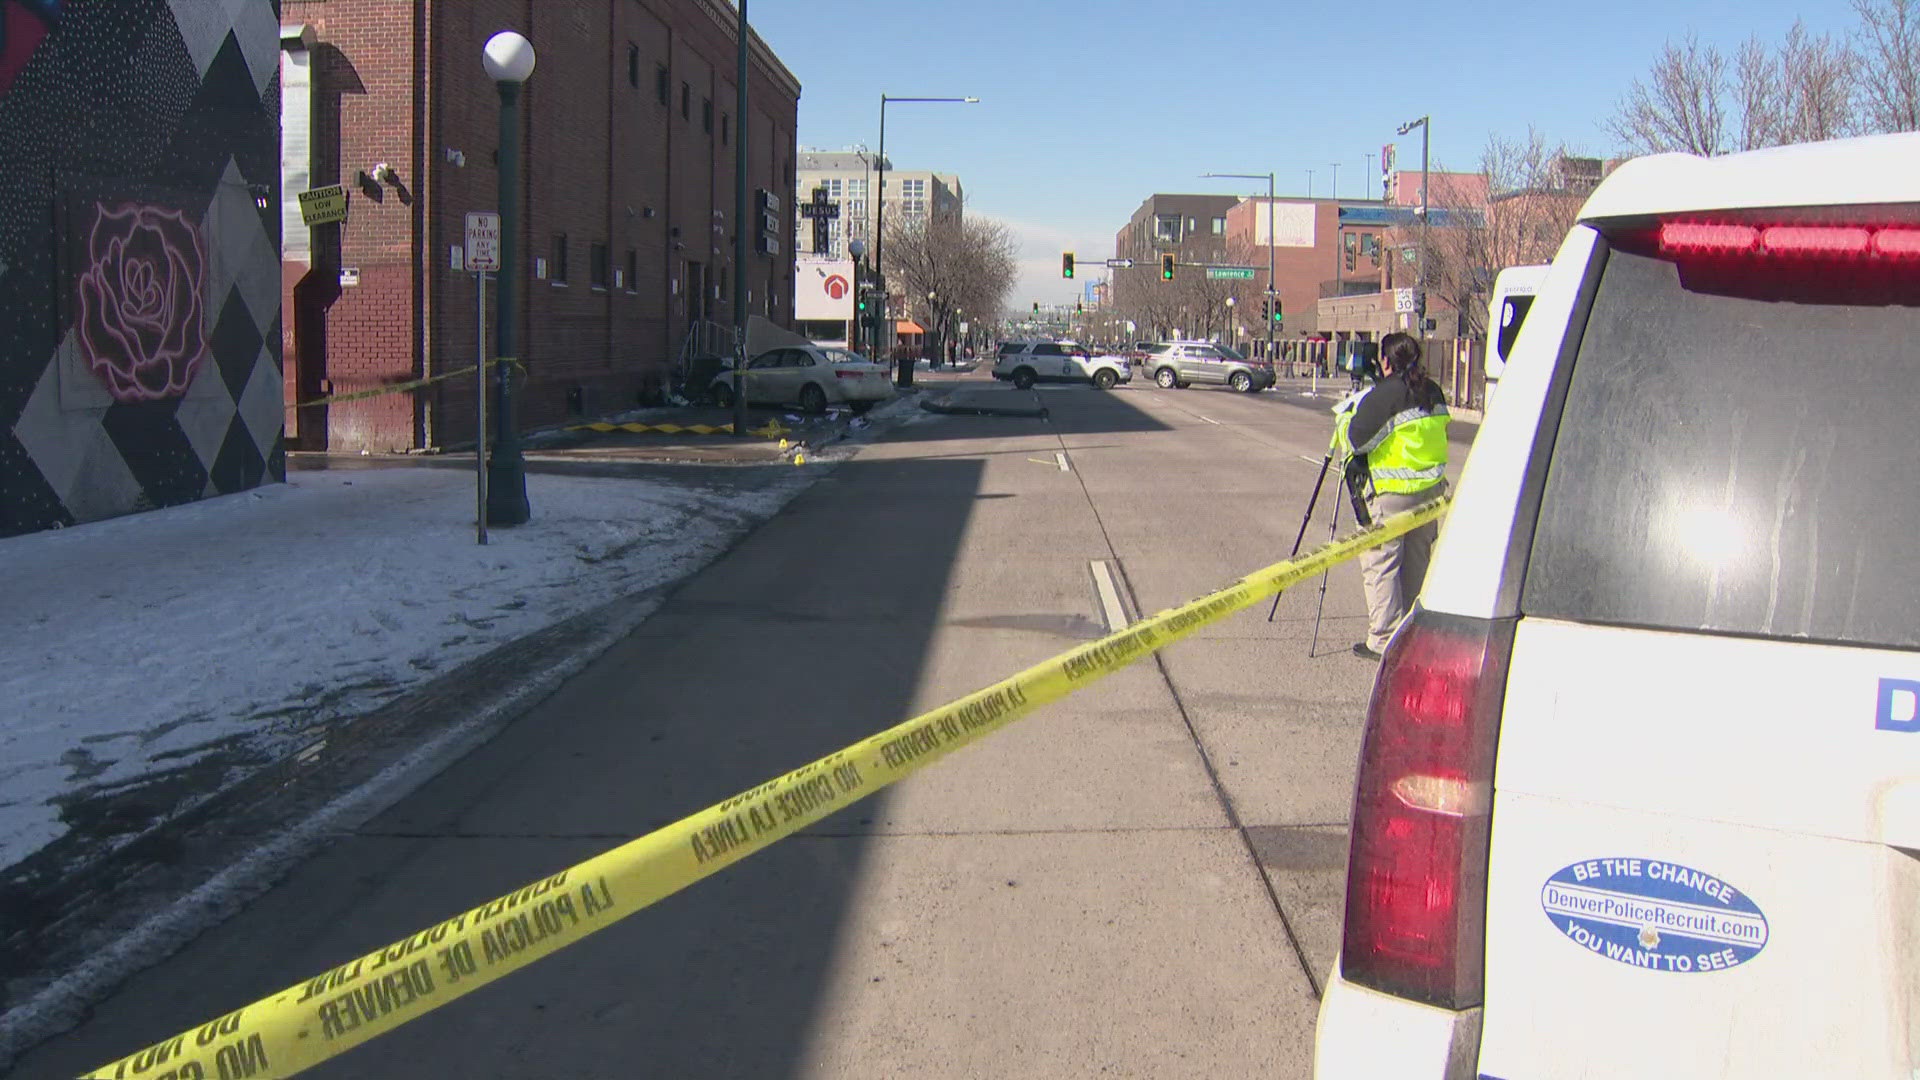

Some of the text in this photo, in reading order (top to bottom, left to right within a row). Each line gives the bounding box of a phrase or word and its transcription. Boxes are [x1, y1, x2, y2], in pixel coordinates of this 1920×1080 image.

[301, 186, 341, 200] CAUTION
[314, 200, 331, 210] LOW
[305, 208, 346, 222] CLEARANCE
[805, 207, 837, 215] JESUS
[478, 217, 488, 228] NO
[468, 229, 498, 240] PARKING
[476, 241, 491, 249] ANY
[476, 249, 491, 257] TIME
[1214, 269, 1245, 279] Lawrence
[1398, 300, 1412, 310] 30
[1572, 859, 1735, 905] BE THE CHANGE
[1548, 889, 1760, 940] DenverPoliceRecruit.com
[1565, 919, 1739, 972] YOU WANT TO SEE
